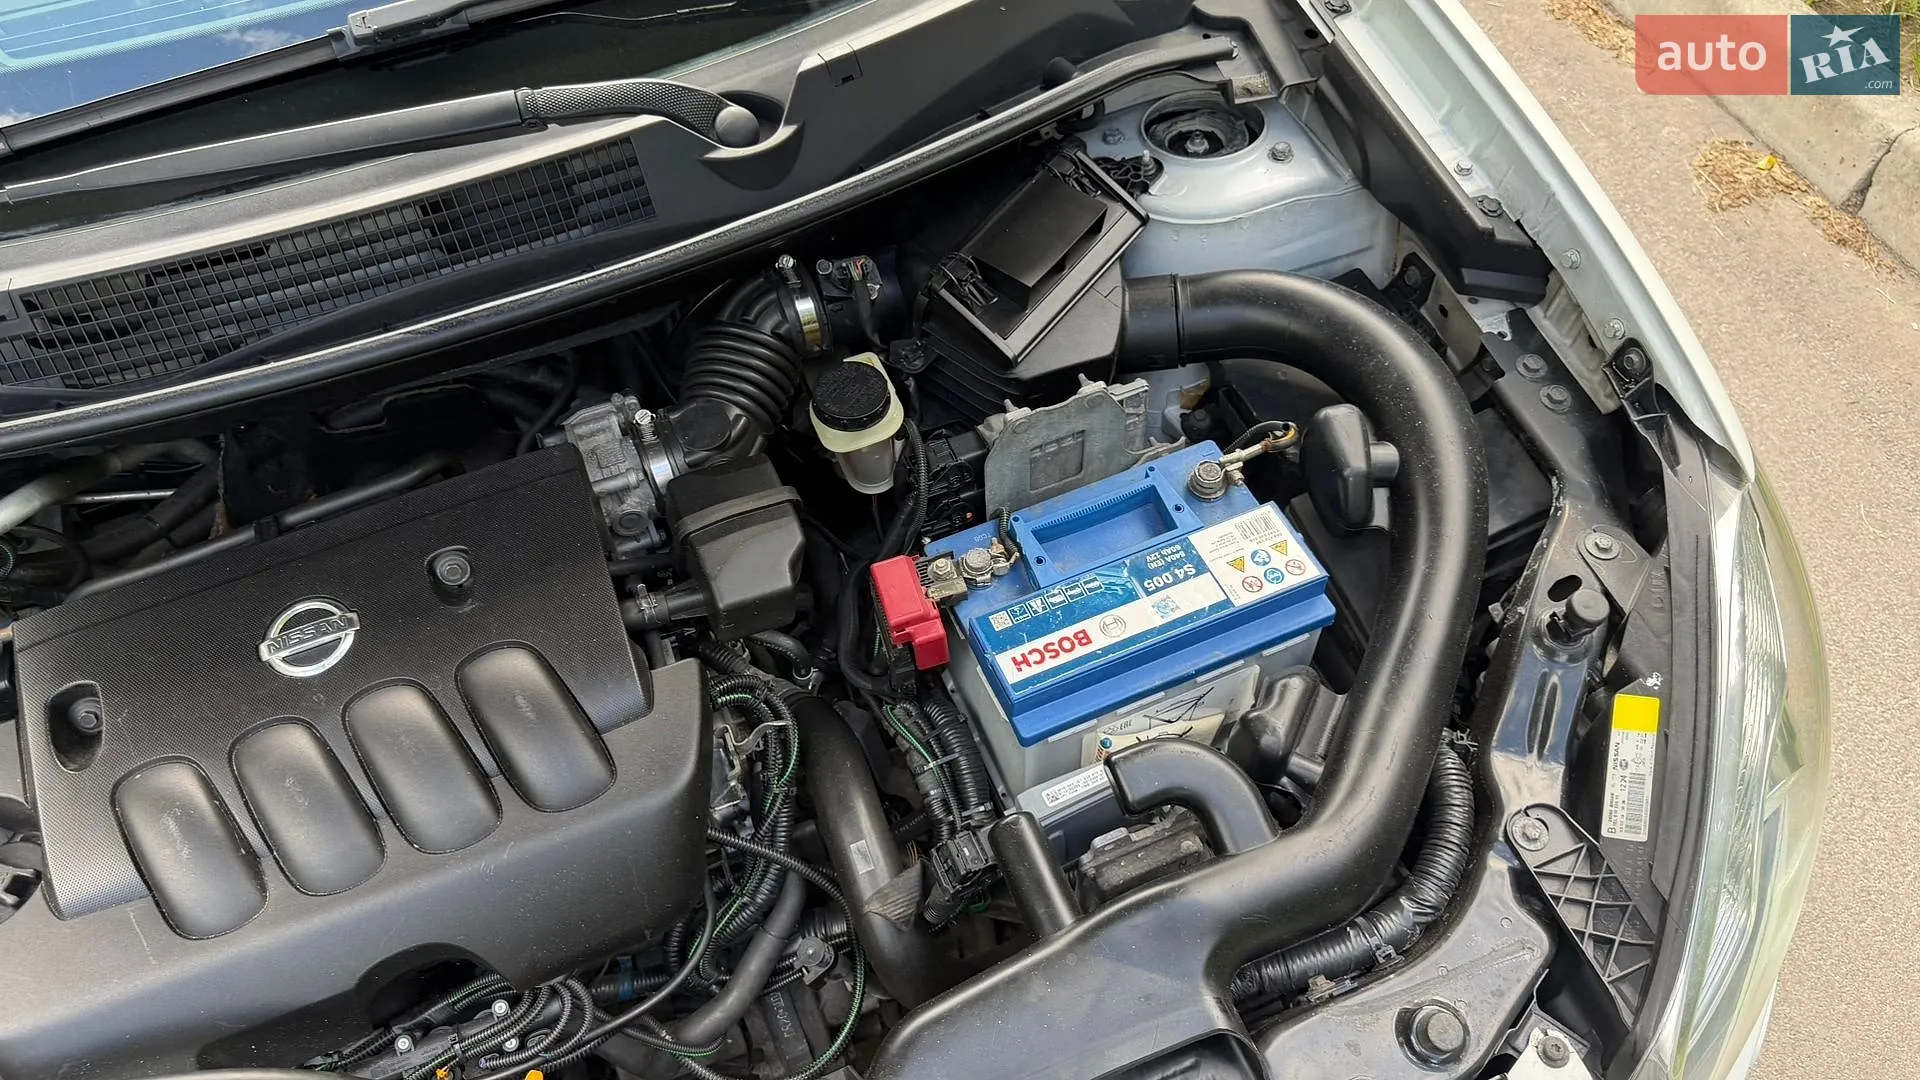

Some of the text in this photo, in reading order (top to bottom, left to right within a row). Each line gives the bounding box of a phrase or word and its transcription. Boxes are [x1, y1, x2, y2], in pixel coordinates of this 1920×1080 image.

[1146, 544, 1181, 563] 60Ah 12V
[1147, 550, 1186, 570] 540A (EN)
[1143, 563, 1196, 592] S4 005
[265, 616, 349, 656] NISSAN
[1011, 628, 1093, 673] BOSCH
[1612, 742, 1621, 771] NISSAN
